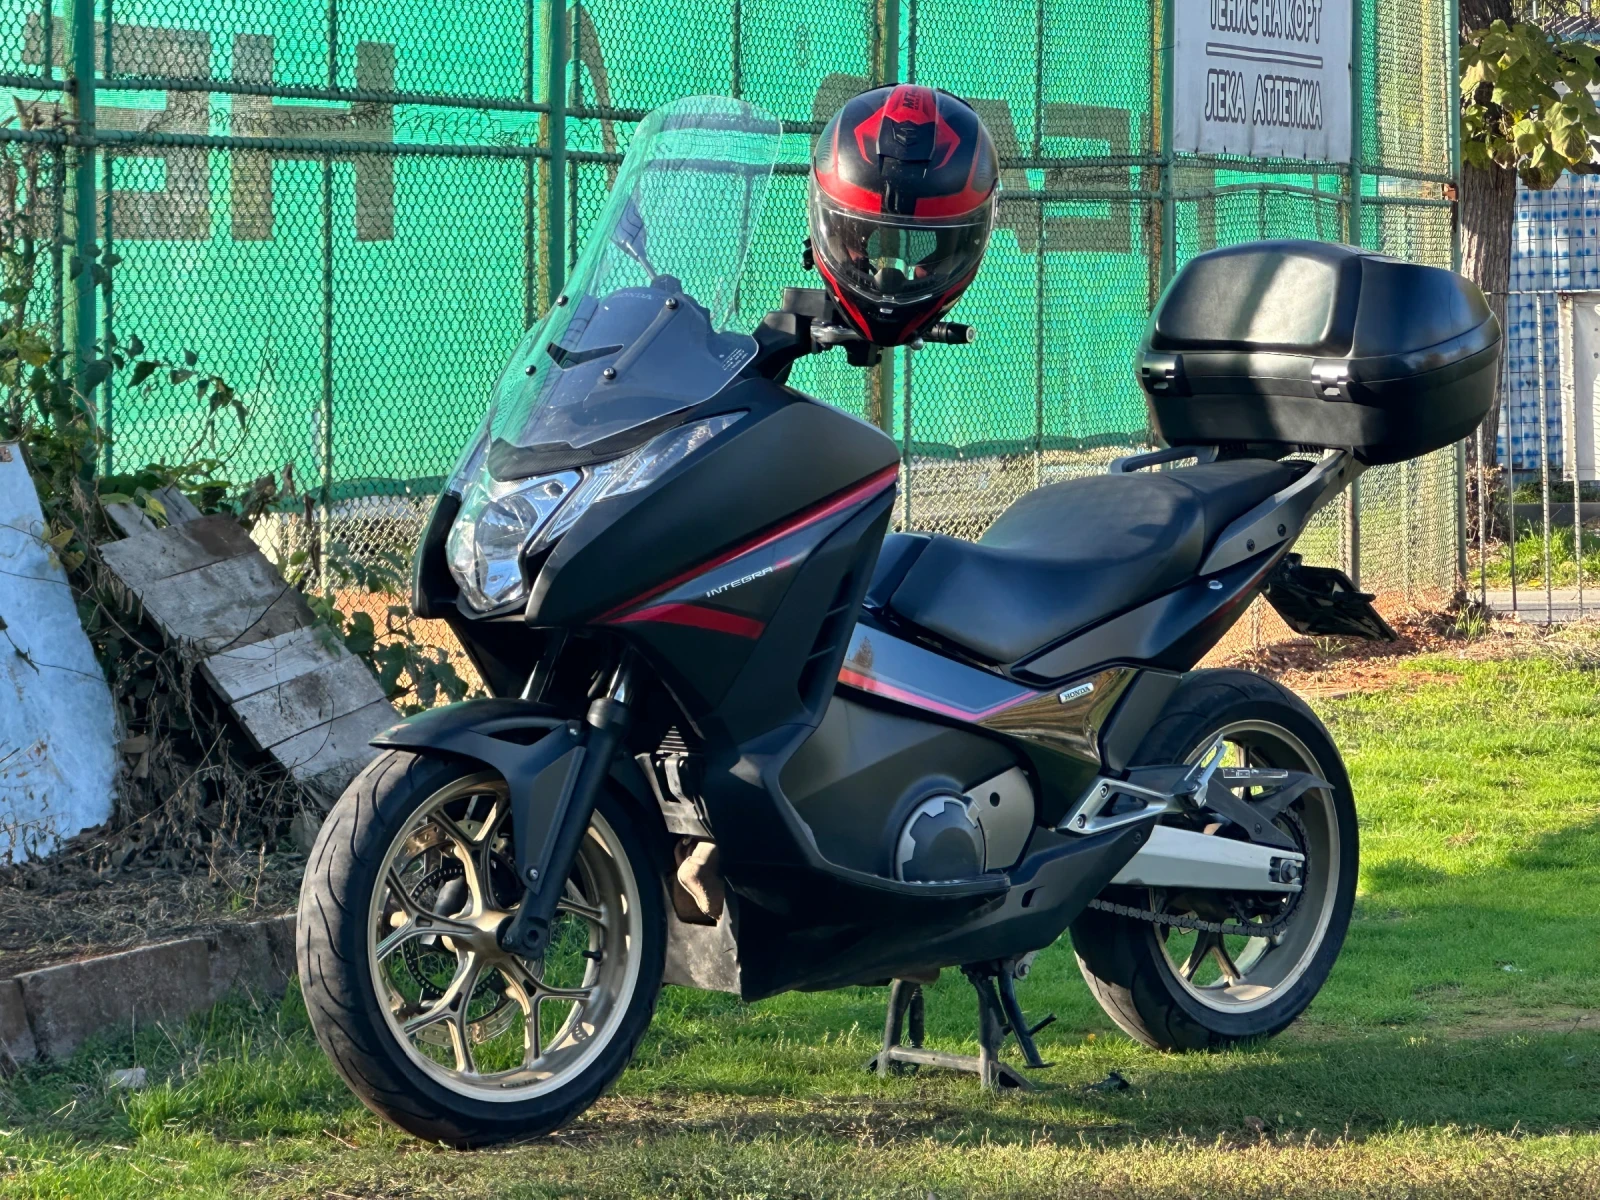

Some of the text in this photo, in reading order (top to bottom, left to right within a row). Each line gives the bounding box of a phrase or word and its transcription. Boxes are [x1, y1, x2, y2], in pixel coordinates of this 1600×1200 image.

[1261, 0, 1283, 39] НА
[1284, 0, 1323, 44] КОРТ
[1204, 68, 1323, 130] ЛЕКА АТЛЕТИКА
[706, 566, 773, 597] INTEGRA
[1064, 686, 1091, 701] HONDA
